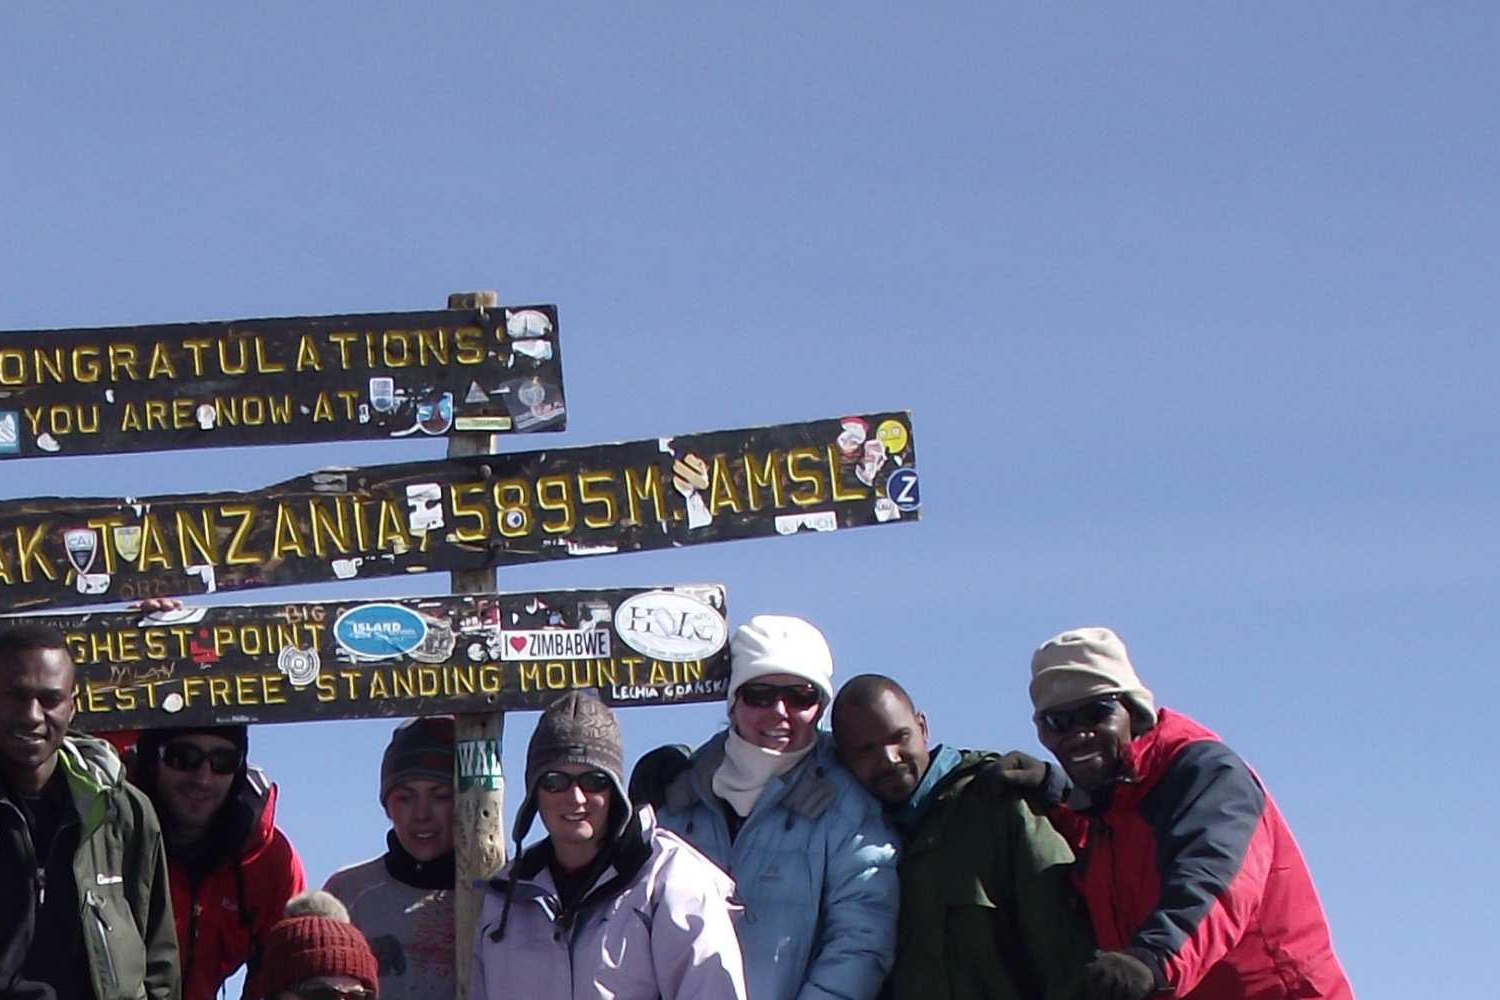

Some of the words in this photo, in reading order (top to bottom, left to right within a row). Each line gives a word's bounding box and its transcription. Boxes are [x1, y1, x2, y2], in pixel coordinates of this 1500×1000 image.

[24, 404, 98, 435] YOU
[121, 398, 197, 432] ARE
[214, 392, 293, 428] NOW
[312, 390, 359, 423] AT
[214, 622, 325, 658] POINT
[504, 639, 509, 656] I
[529, 631, 608, 657] ZIMBABWE
[520, 656, 705, 692] MOUNTAIN
